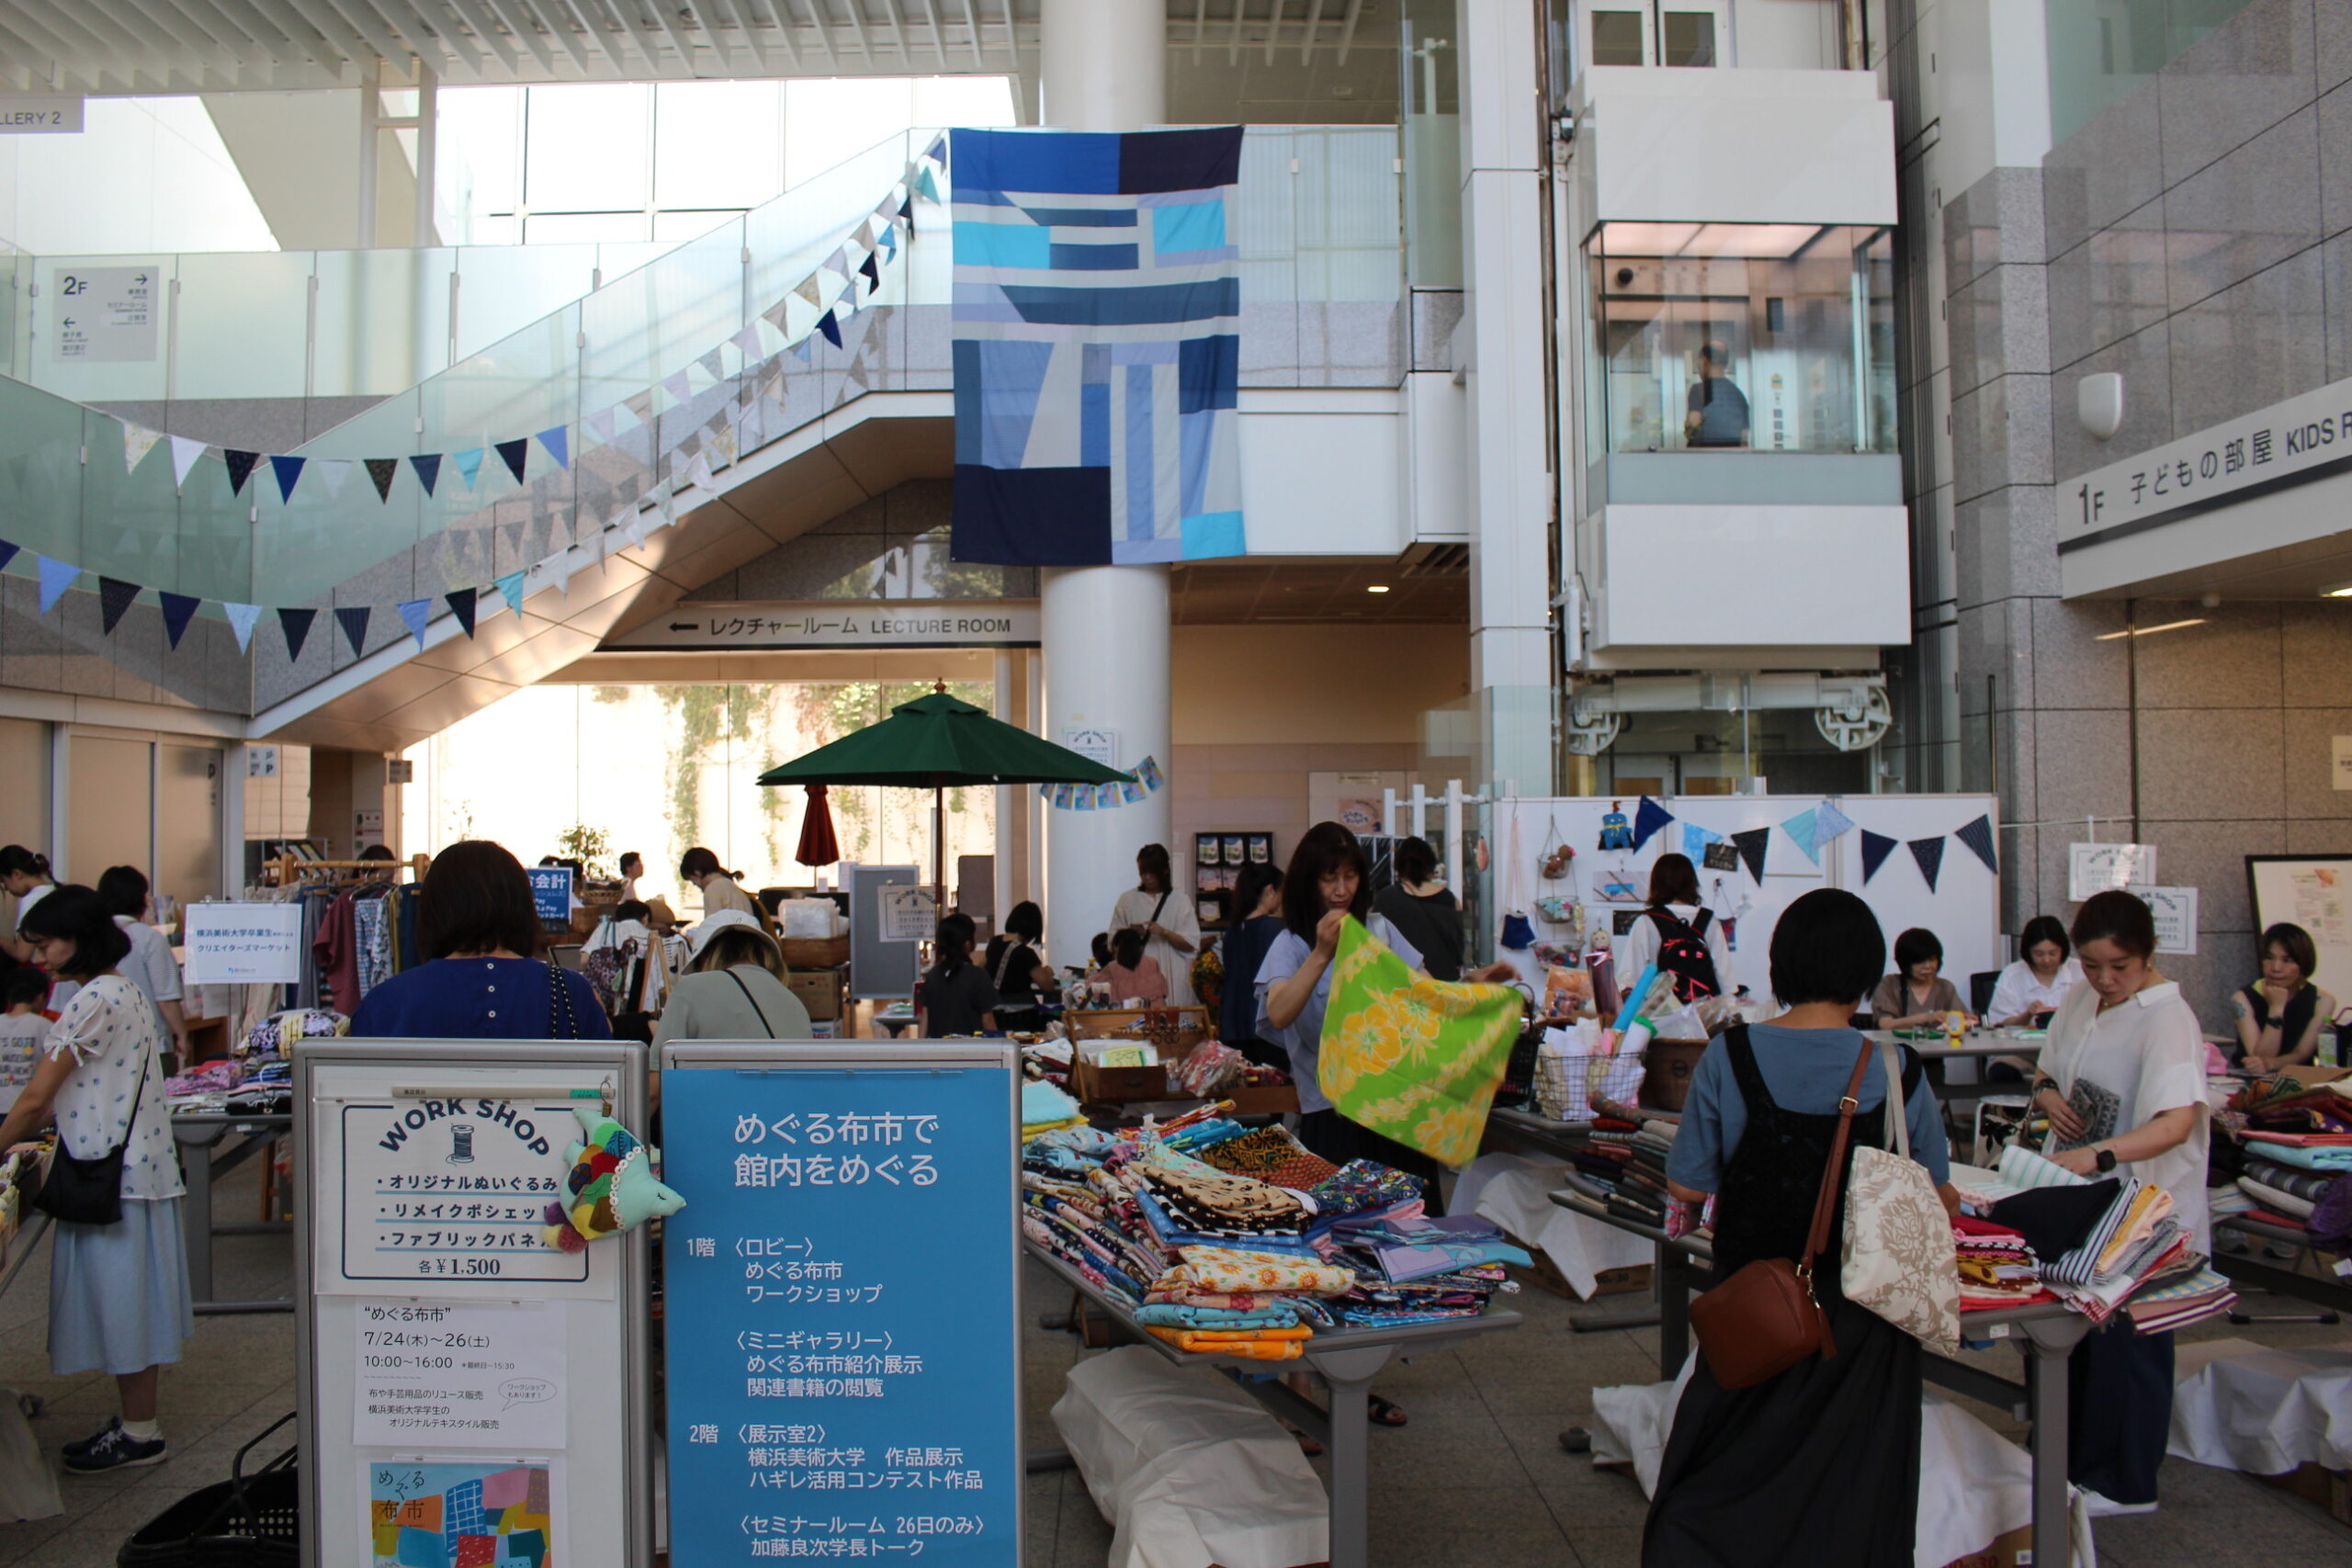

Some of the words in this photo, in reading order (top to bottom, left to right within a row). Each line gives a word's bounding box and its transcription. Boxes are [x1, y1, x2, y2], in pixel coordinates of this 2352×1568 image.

[51, 111, 62, 125] 2
[63, 276, 88, 295] 2F
[2078, 483, 2105, 525] 1F
[2131, 429, 2274, 504] 子どもの部屋
[2287, 418, 2335, 457] KIDS
[710, 616, 859, 636] レクチャールーム
[872, 619, 952, 634] LECTURE
[957, 618, 1011, 633] ROOM
[379, 1098, 467, 1153] WORK
[476, 1099, 549, 1156] SHOP
[735, 1111, 940, 1146] めぐる布市で
[734, 1153, 939, 1188] 館内をめぐる
[686, 1237, 716, 1258] 1階
[745, 1260, 843, 1280] めぐる布市
[746, 1284, 884, 1303] ワークショップ
[747, 1354, 922, 1374] めぐる布市紹介展示
[368, 1388, 484, 1401] 布や手芸用品のリユース販売
[747, 1378, 884, 1398] 関連書籍の閲覧
[368, 1404, 450, 1416] 横浜美術大学学生の
[390, 1418, 500, 1429] オリジナルテキスタイル販売
[689, 1425, 718, 1444] 2階
[748, 1447, 866, 1468] 横浜美術大学
[885, 1447, 965, 1467] 作品展示
[749, 1470, 983, 1490] ハギレ活用コンテスト作品
[751, 1538, 924, 1558] 加藤良次学長トーク
